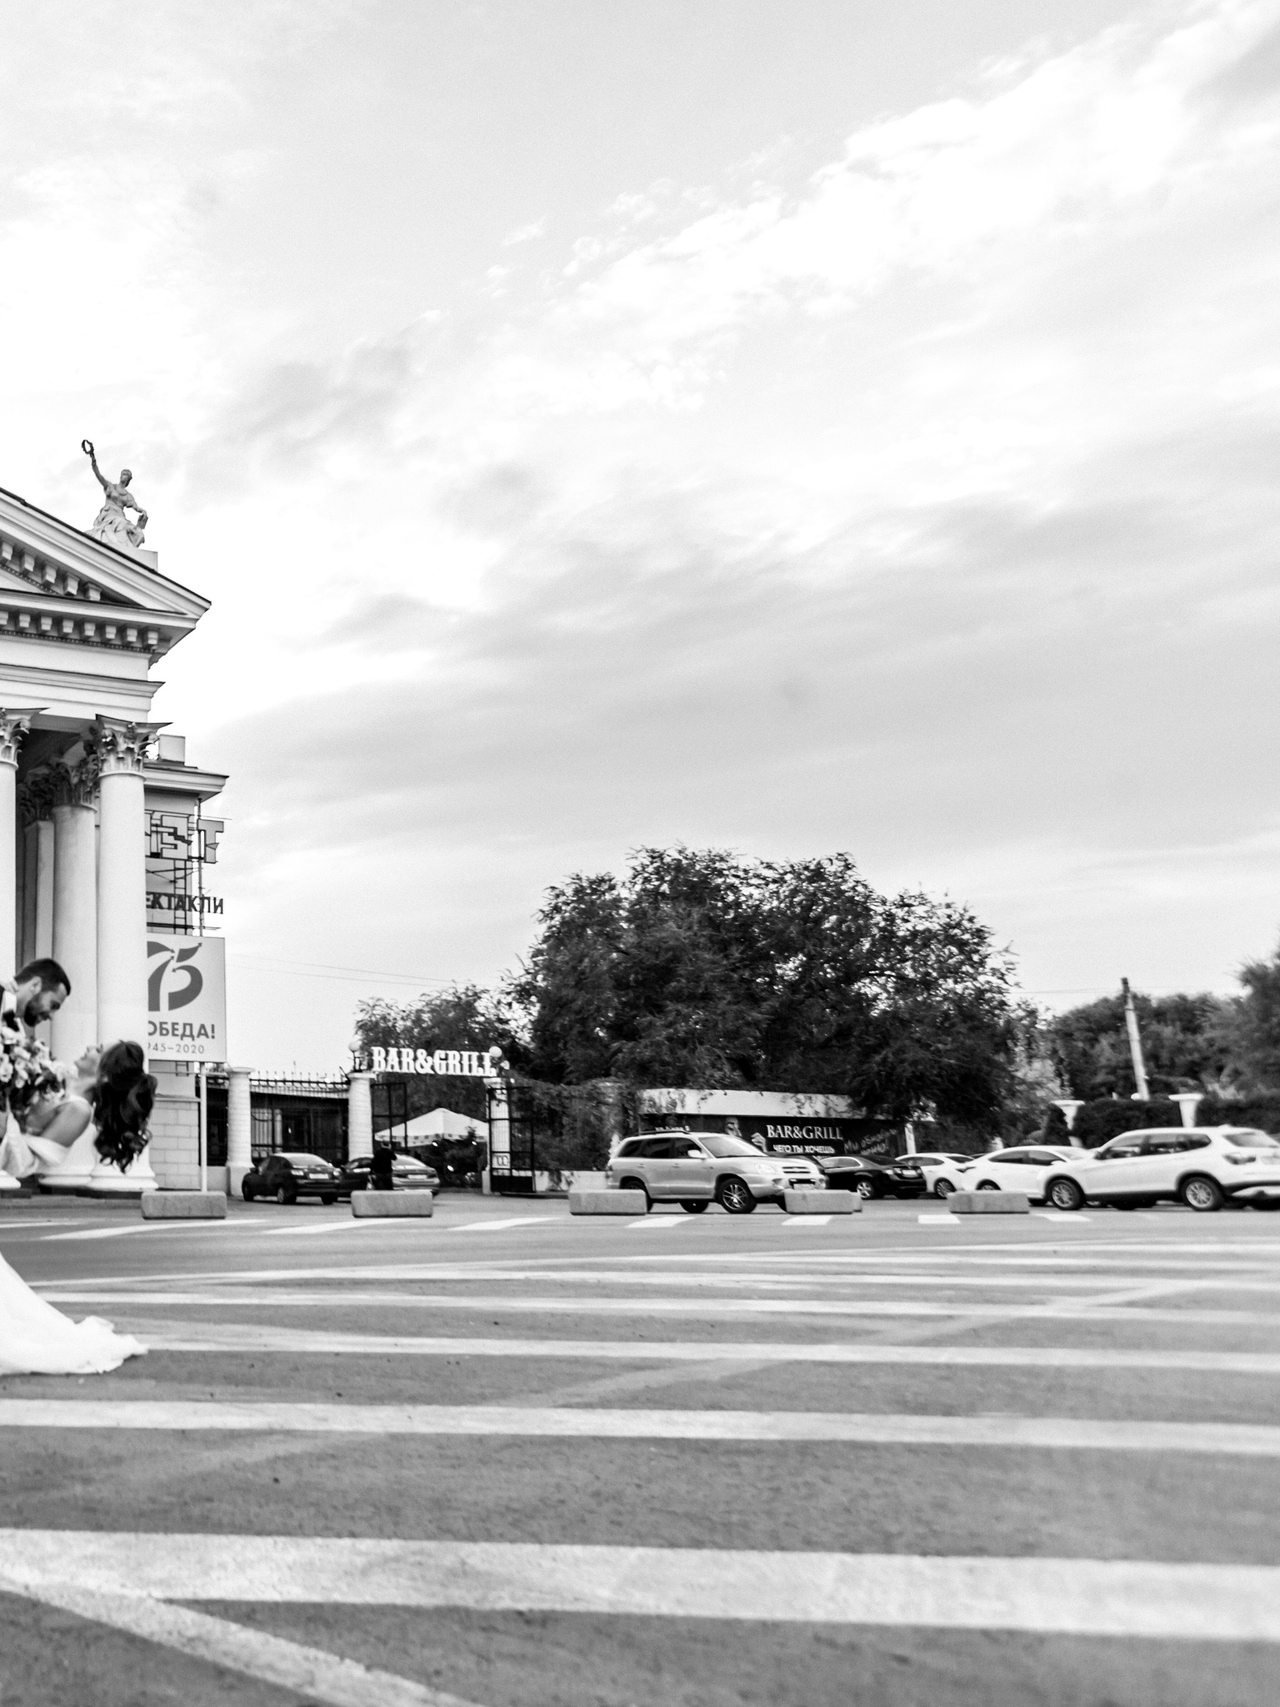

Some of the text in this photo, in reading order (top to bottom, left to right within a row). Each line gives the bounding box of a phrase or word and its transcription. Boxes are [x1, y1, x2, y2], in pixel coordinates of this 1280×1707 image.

[371, 1046, 497, 1077] BAR&GRILL
[766, 1124, 844, 1140] BAR&GRILL
[773, 1144, 792, 1153] ЧЕГО
